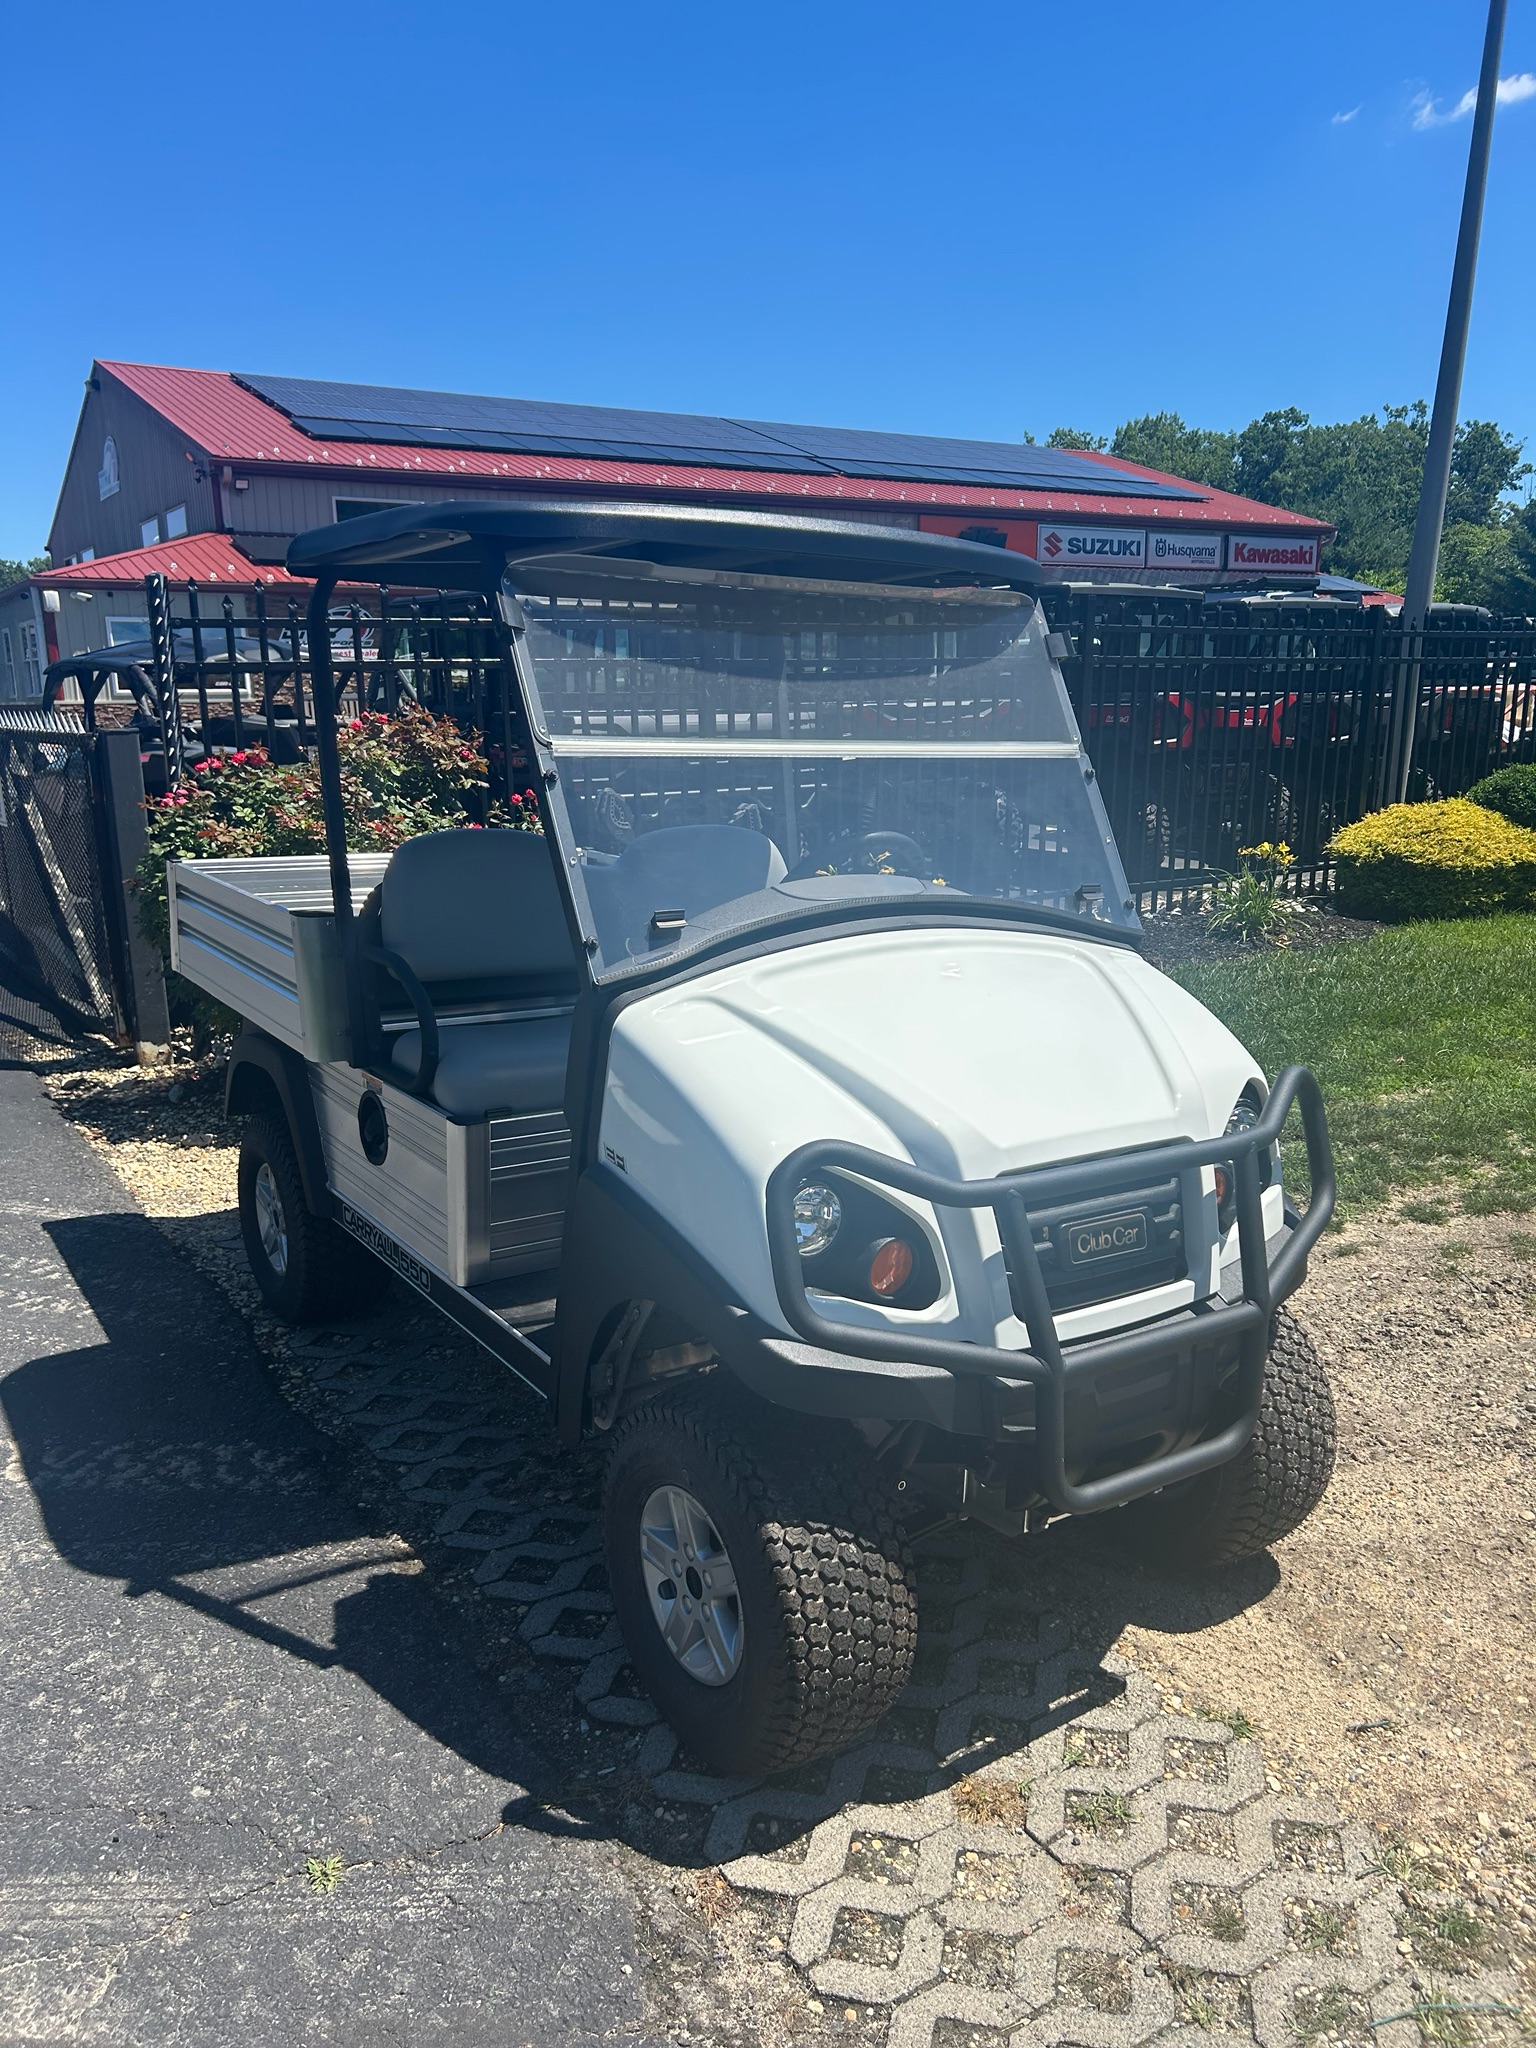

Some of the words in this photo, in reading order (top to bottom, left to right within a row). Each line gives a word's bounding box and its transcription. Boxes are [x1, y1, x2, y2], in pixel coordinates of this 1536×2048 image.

[1067, 537, 1141, 557] SUZUKI
[1167, 543, 1216, 558] Husqvarna
[1234, 542, 1314, 565] Kawasaki
[343, 1203, 399, 1268] CARRYALL
[399, 1246, 431, 1293] 550
[1077, 1231, 1112, 1254] Club
[1113, 1226, 1139, 1245] Car
